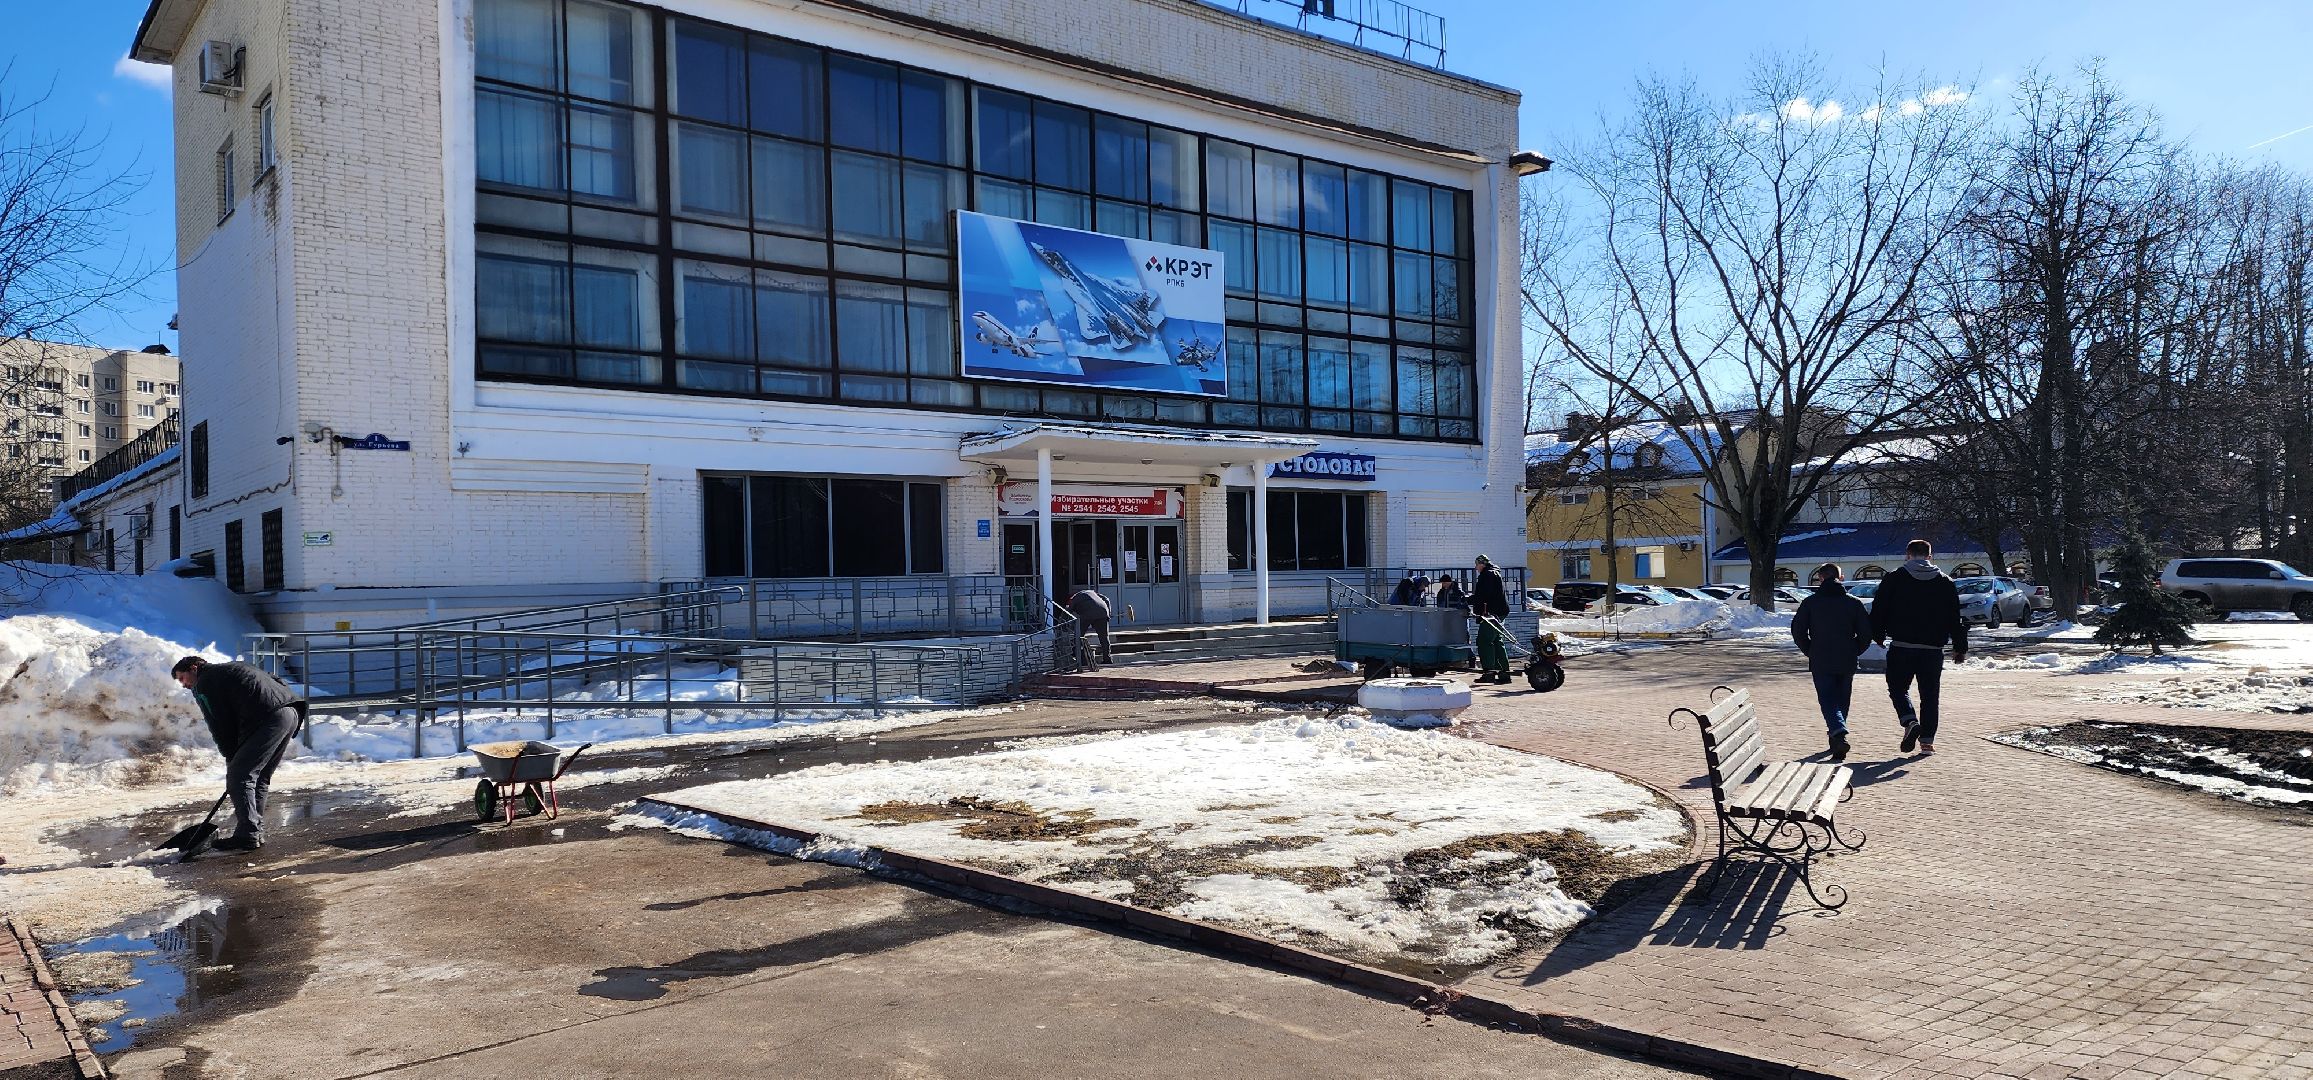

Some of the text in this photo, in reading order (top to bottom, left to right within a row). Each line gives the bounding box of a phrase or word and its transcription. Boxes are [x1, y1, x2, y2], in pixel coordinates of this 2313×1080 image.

[1165, 257, 1213, 280] КРЭТ
[1166, 278, 1185, 288] РПКБ
[1278, 456, 1375, 476] СТОЛОВАЯ
[1117, 497, 1149, 506] участки
[1061, 504, 1071, 512] №
[1120, 505, 1139, 513] 2545
